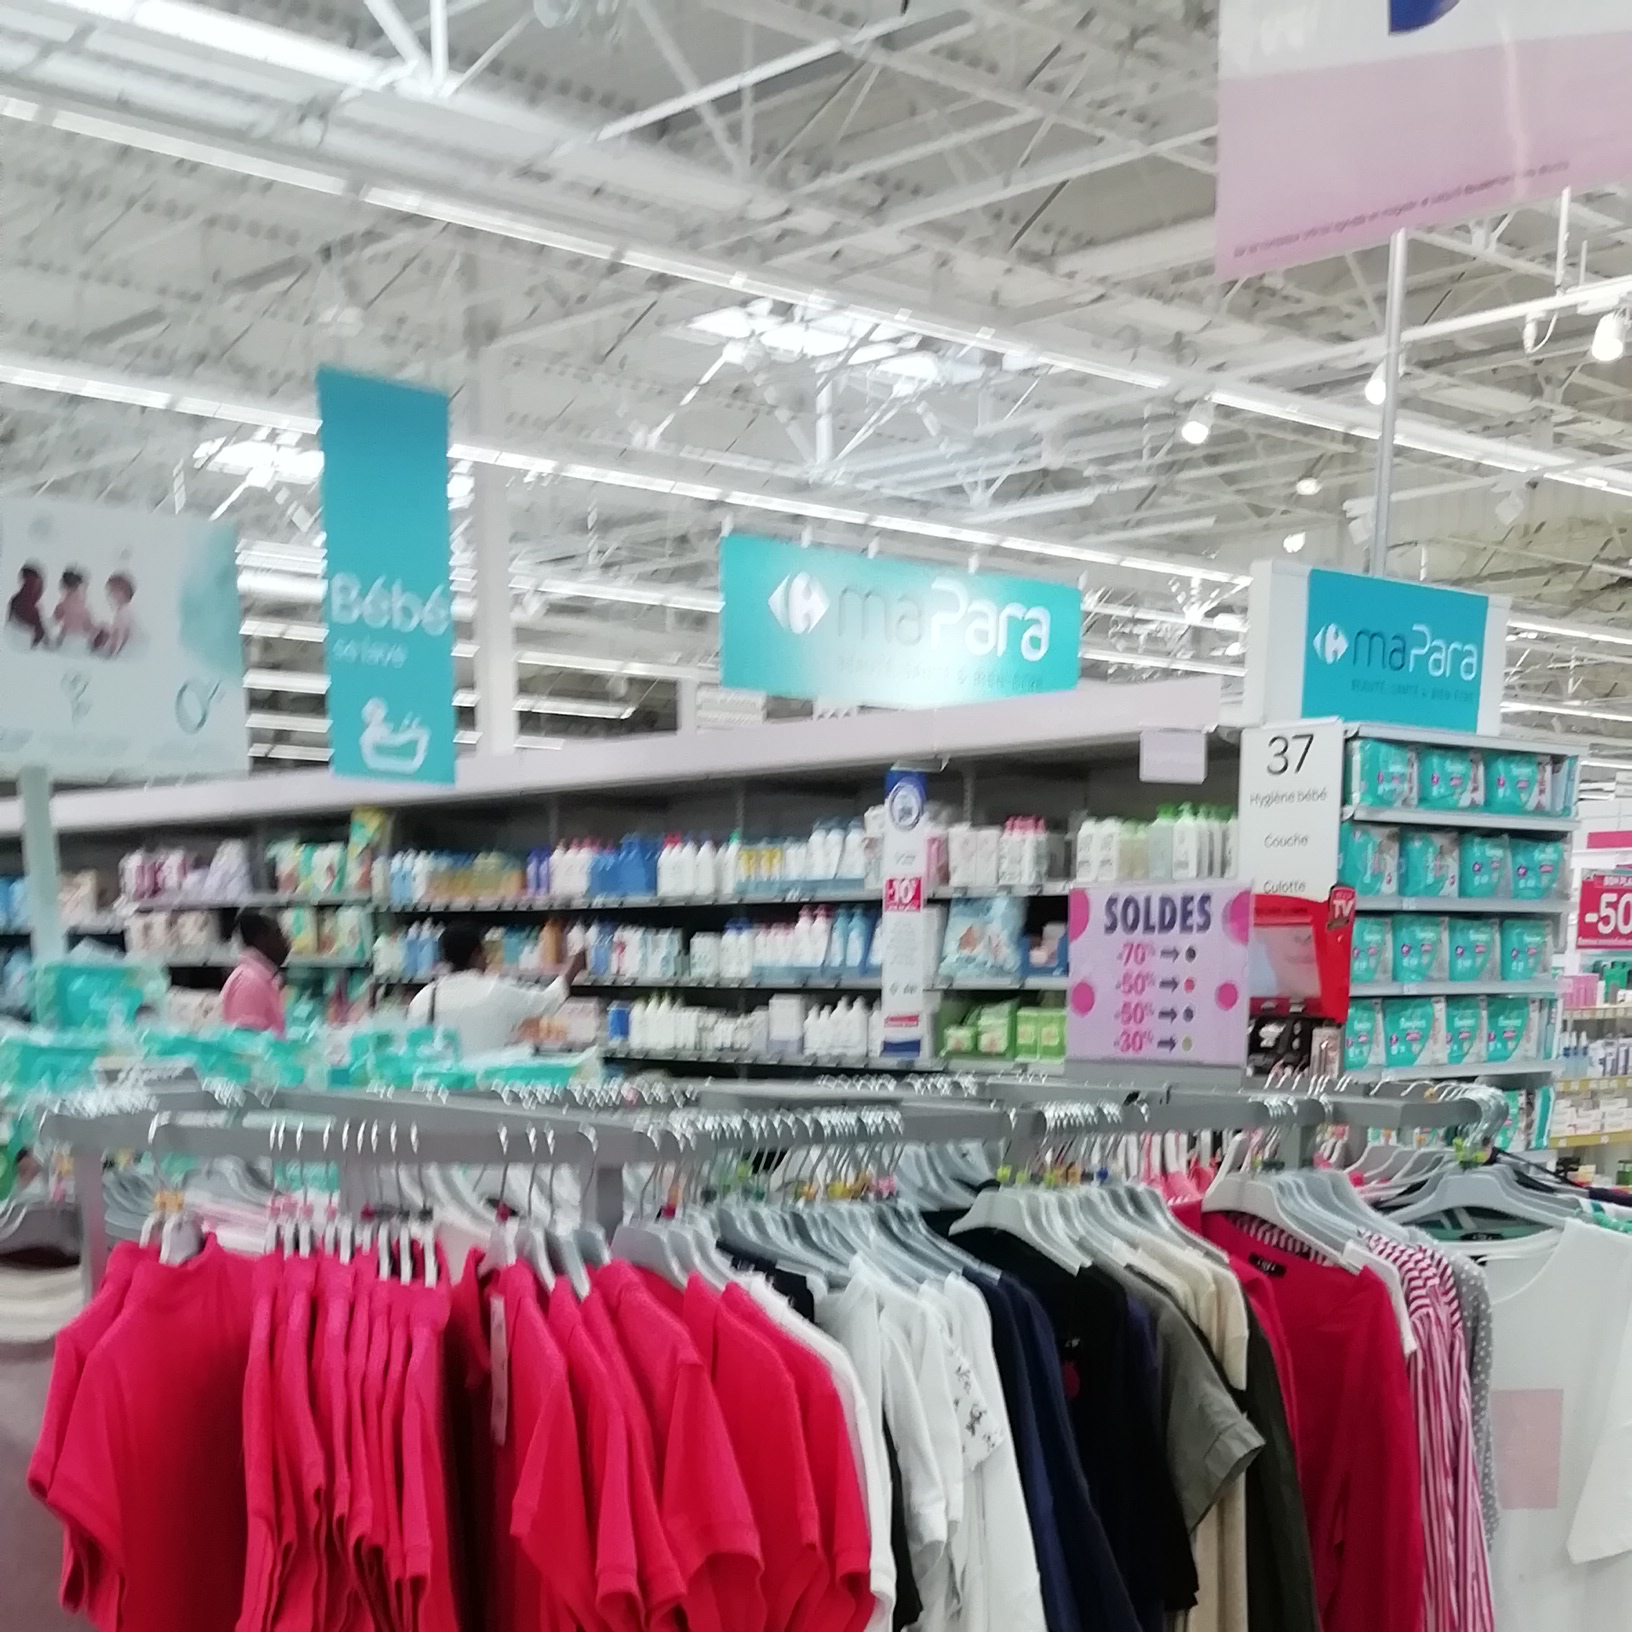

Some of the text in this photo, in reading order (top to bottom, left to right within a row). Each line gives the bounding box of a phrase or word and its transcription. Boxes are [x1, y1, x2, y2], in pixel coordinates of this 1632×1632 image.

[331, 572, 450, 636] Bébé
[1352, 623, 1478, 681] maPara
[1267, 734, 1314, 776] 37
[1104, 893, 1212, 935] SOLDES
